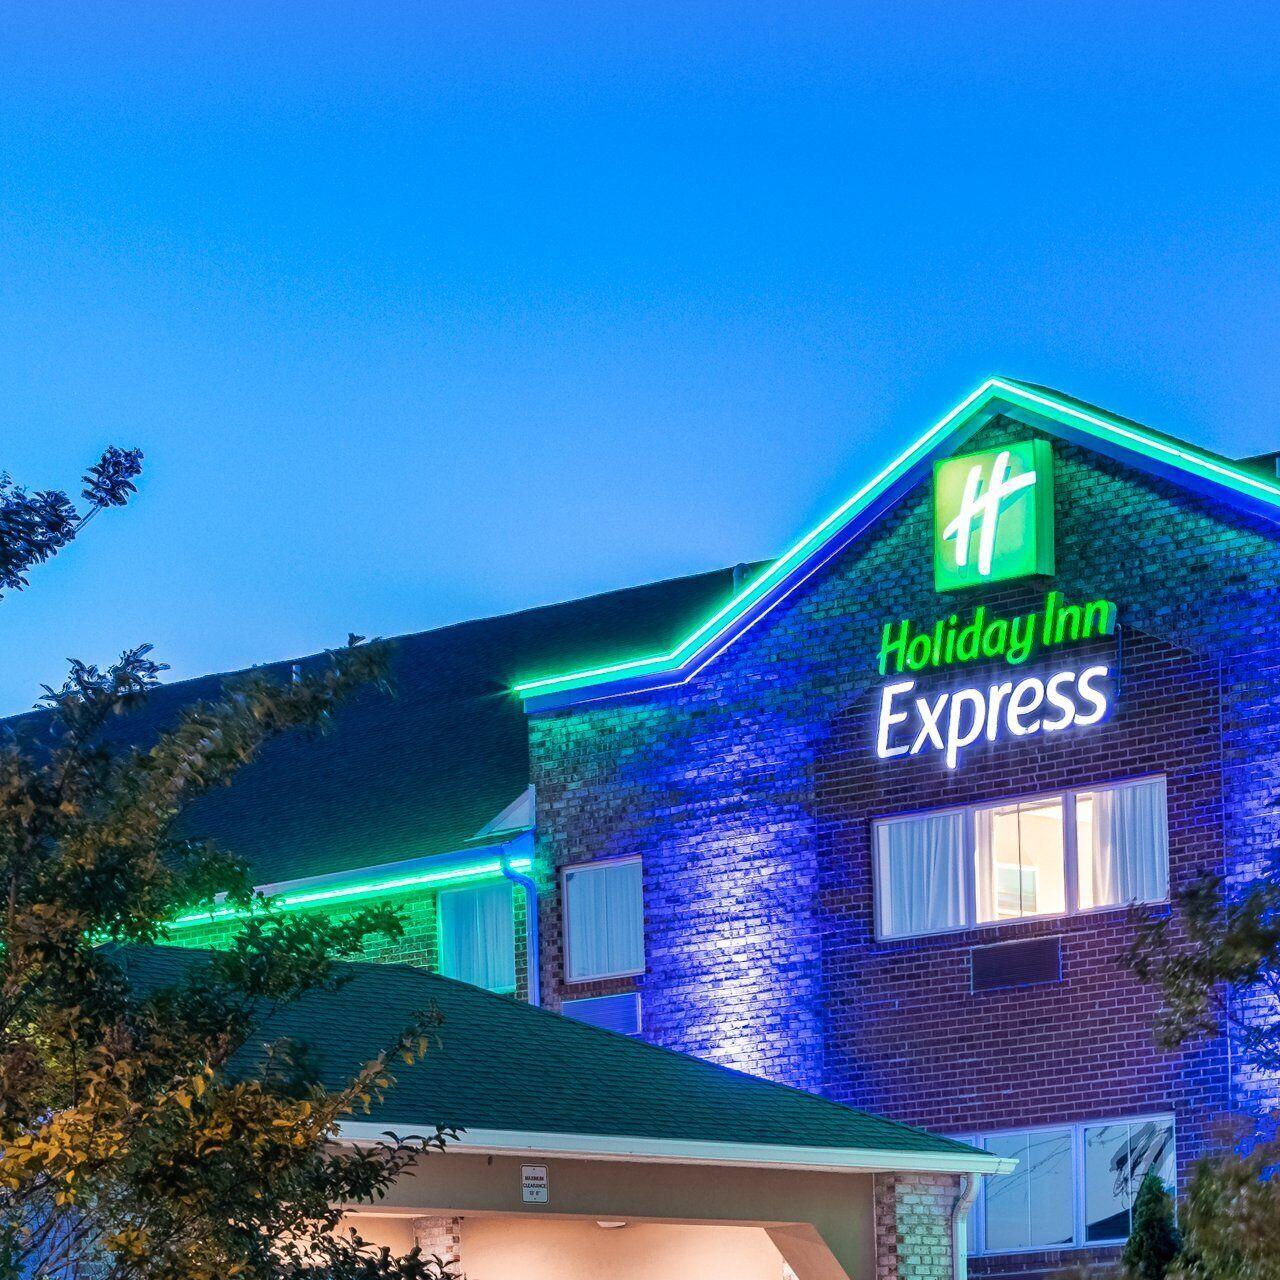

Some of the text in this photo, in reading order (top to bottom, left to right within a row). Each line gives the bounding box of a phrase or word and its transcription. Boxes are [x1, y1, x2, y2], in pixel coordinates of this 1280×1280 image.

[877, 591, 1116, 675] Holiday Inn
[876, 665, 1109, 769] Express
